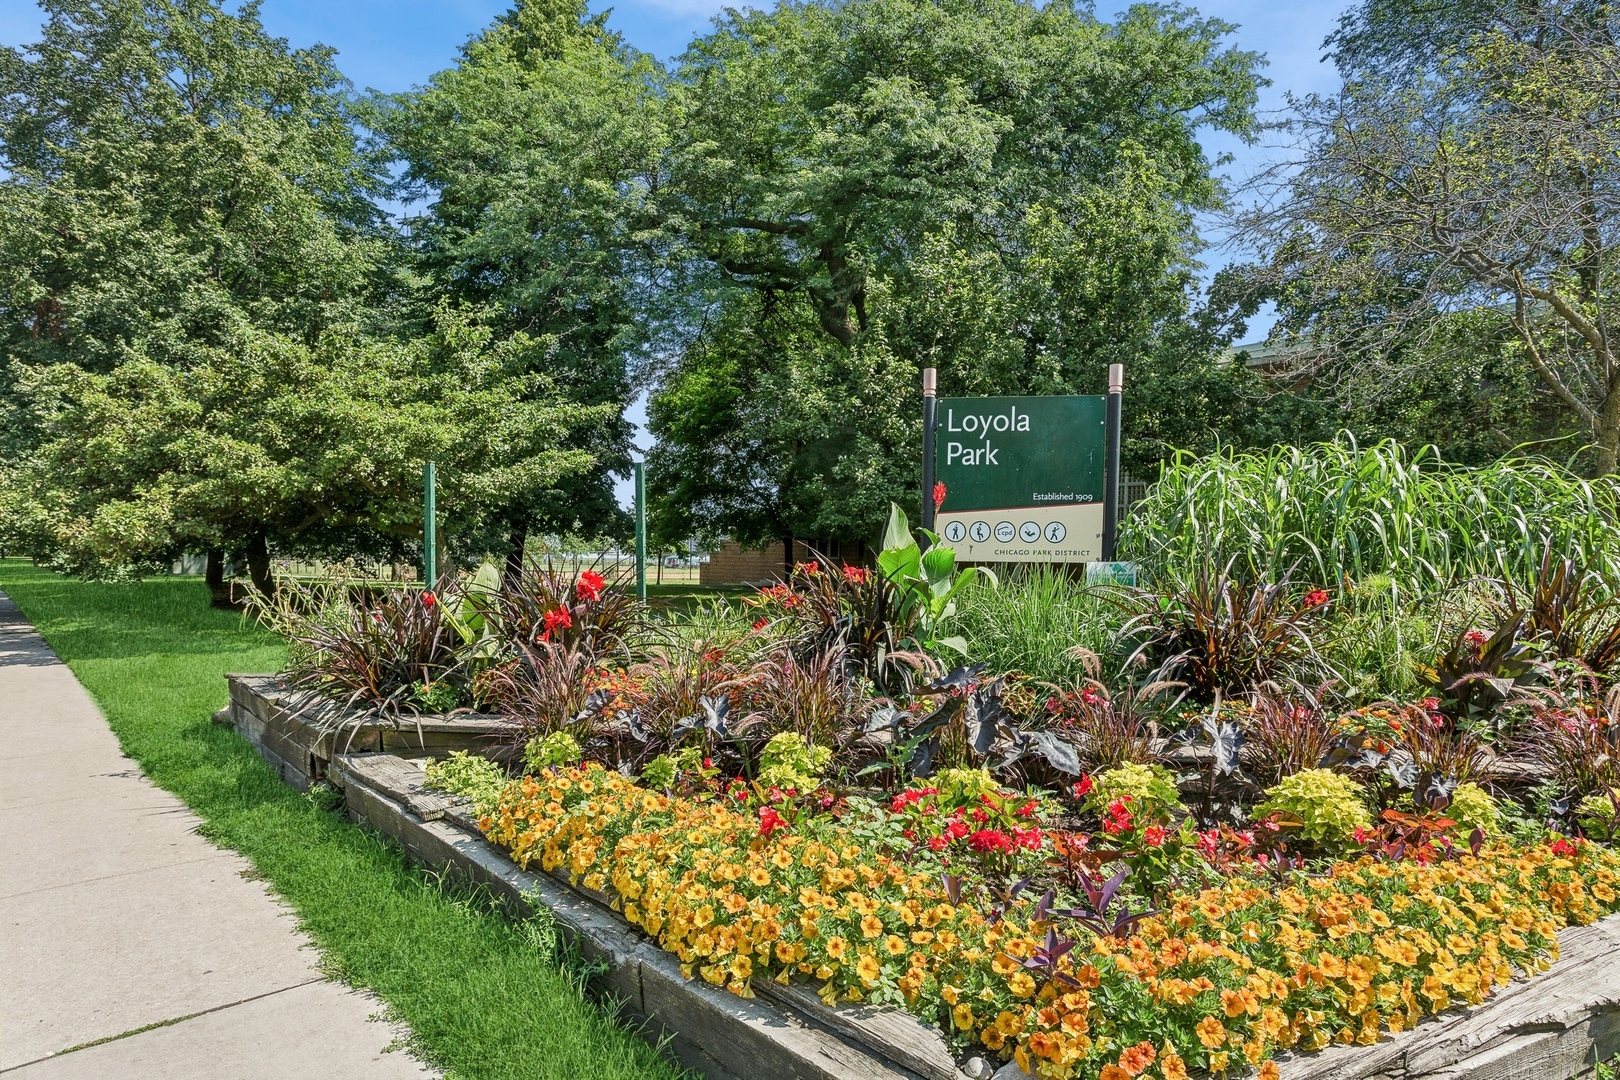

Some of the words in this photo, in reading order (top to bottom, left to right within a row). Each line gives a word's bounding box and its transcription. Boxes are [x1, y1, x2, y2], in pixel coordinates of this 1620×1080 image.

[948, 405, 1030, 440] Loyola
[947, 440, 999, 465] Park
[1032, 492, 1074, 501] Established
[1075, 493, 1093, 502] 1909
